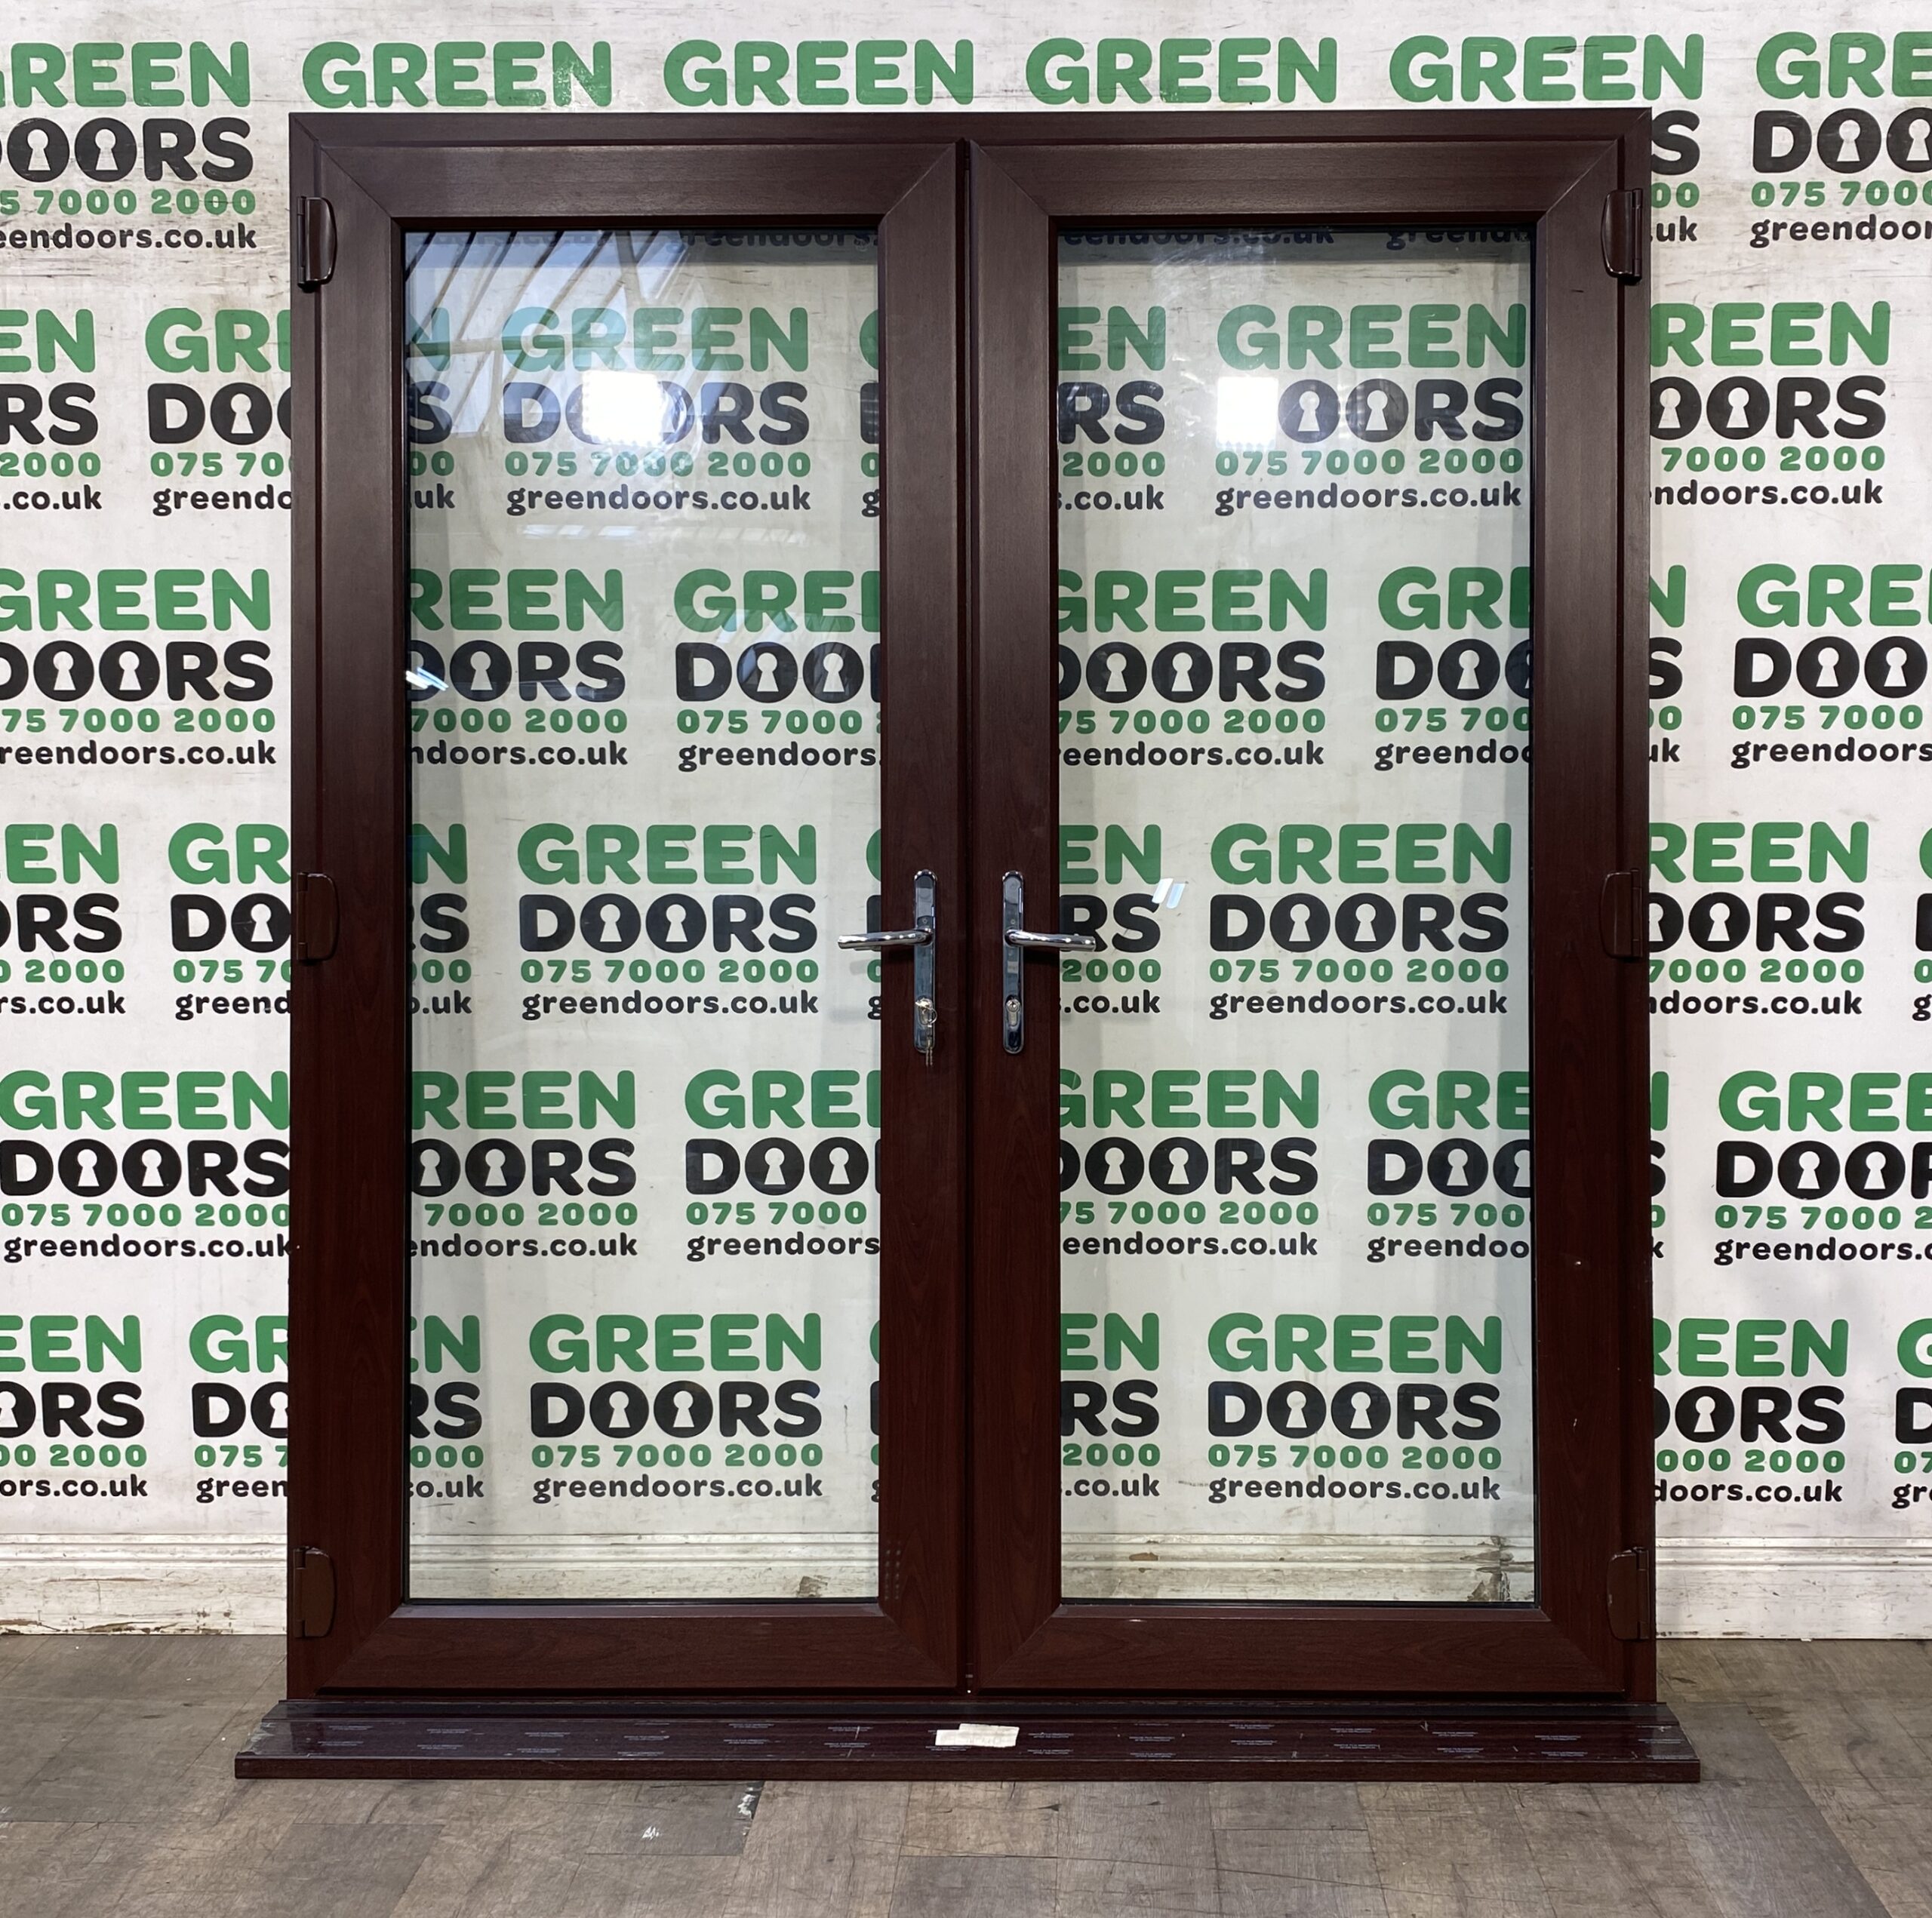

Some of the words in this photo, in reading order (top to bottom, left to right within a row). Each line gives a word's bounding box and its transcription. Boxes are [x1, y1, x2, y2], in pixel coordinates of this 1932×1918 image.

[0, 41, 251, 108] REEN
[302, 41, 612, 109] GREEN
[663, 39, 974, 107] GREEN
[1025, 37, 1337, 105] GREEN
[1389, 34, 1704, 103] GREEN
[1755, 31, 1932, 100] GRE
[0, 117, 254, 183] OORS
[1752, 107, 1932, 174] DOO
[33, 189, 137, 216] 7000
[151, 189, 257, 216] 2000
[1751, 181, 1826, 207] 075
[502, 306, 809, 371] GREEN
[1217, 303, 1527, 370] GREEN
[1651, 301, 1891, 367] REEN
[1278, 378, 1524, 444] OORS
[1651, 375, 1887, 441] OORS
[0, 452, 101, 478] 2000
[150, 452, 223, 478] 075
[504, 451, 577, 477] 075
[592, 451, 694, 477] 7000
[708, 451, 811, 478] 2000
[1062, 451, 1166, 478] 2000
[1215, 450, 1287, 477] 075
[1301, 449, 1405, 475] 7000
[1419, 448, 1524, 474] 2000
[1661, 447, 1766, 472] 7000
[1780, 445, 1885, 472] 2000
[506, 484, 811, 517] greendoors.co.uk
[1214, 481, 1522, 517] greendoors.co.uk
[1651, 478, 1883, 506] ndoors.co.uk
[411, 568, 624, 632] REEN
[1737, 564, 1932, 628] GRE
[675, 641, 881, 703] DOO
[1733, 636, 1928, 699] DOO
[1, 708, 47, 733] 75
[58, 708, 161, 733] 7000
[174, 708, 275, 733] 2000
[411, 708, 512, 733] 7000
[525, 708, 628, 734] 2000
[676, 709, 749, 734] 075
[761, 709, 863, 735] 7000
[1060, 710, 1097, 735] 75
[1109, 709, 1211, 735] 7000
[1223, 708, 1326, 733] 2000
[1374, 708, 1447, 733] 075
[1460, 707, 1530, 732] 700
[1732, 705, 1805, 730] 075
[1819, 705, 1924, 730] 7000
[0, 739, 277, 765] reendoors.co.uk
[411, 739, 629, 766] ndoors.co.uk
[1060, 740, 1324, 767] eendoors.co.uk
[1730, 736, 1932, 770] greendoors
[518, 822, 817, 885] GREEN
[1210, 822, 1512, 885] GREEN
[1650, 822, 1869, 884] REEN
[518, 893, 818, 954] DOORS
[1209, 893, 1509, 954] DOORS
[1650, 892, 1866, 953] OORS
[24, 959, 125, 984] 2000
[173, 959, 244, 984] 075
[520, 959, 592, 984] 075
[604, 959, 706, 984] 7000
[718, 959, 819, 984] 2000
[1062, 959, 1161, 983] 2000
[1209, 959, 1280, 983] 075
[1292, 959, 1393, 983] 7000
[1406, 959, 1509, 983] 2000
[1650, 959, 1746, 983] 7000
[1759, 959, 1865, 984] 2000
[521, 989, 819, 1021] greendoors.co.uk
[1208, 989, 1508, 1020] greendoors.co.uk
[0, 1070, 289, 1131] GREEN
[411, 1070, 636, 1130] REEN
[684, 1069, 880, 1130] GRE
[1367, 1068, 1531, 1130] GRE
[0, 1139, 288, 1198] DOORS
[411, 1138, 637, 1198] OORS
[685, 1137, 880, 1197] DOO
[1367, 1138, 1531, 1198] DOO
[1, 1203, 71, 1227] 075
[82, 1203, 182, 1227] 7000
[195, 1203, 288, 1228] 2000
[424, 1203, 525, 1227] 7000
[537, 1202, 638, 1226] 2000
[685, 1201, 755, 1225] 075
[768, 1201, 867, 1225] 7000
[1107, 1201, 1207, 1225] 7000
[1219, 1201, 1319, 1226] 2000
[1367, 1203, 1438, 1227] 075
[1450, 1203, 1525, 1228] 700
[1714, 1205, 1787, 1230] 075
[1800, 1206, 1902, 1231] 7000
[686, 1231, 880, 1262] greendoors
[1062, 1231, 1318, 1256] eendoors.co.uk
[1366, 1233, 1531, 1262] greendoo
[528, 1313, 822, 1374] GREEN
[1208, 1313, 1503, 1375] GREEN
[0, 1381, 145, 1439] ORS
[530, 1380, 823, 1439] DOORS
[1208, 1380, 1502, 1440] DOORS
[49, 1444, 147, 1468] 2000
[194, 1445, 263, 1468] 075
[411, 1445, 485, 1468] 000
[531, 1444, 601, 1468] 075
[613, 1444, 712, 1468] 7000
[724, 1443, 823, 1468] 2000
[1062, 1443, 1161, 1467] 2000
[1208, 1444, 1277, 1468] 075
[1289, 1445, 1389, 1469] 7000
[1401, 1446, 1502, 1471] 2000
[1656, 1449, 1731, 1472] 000
[1744, 1449, 1846, 1474] 2000
[1894, 1451, 1932, 1474] 07
[0, 1474, 149, 1497] ors.co.uk
[532, 1473, 823, 1504] greendoors.co.uk
[1208, 1474, 1501, 1504] greendoors.co.uk
[1654, 1477, 1843, 1503] doors.co.uk
